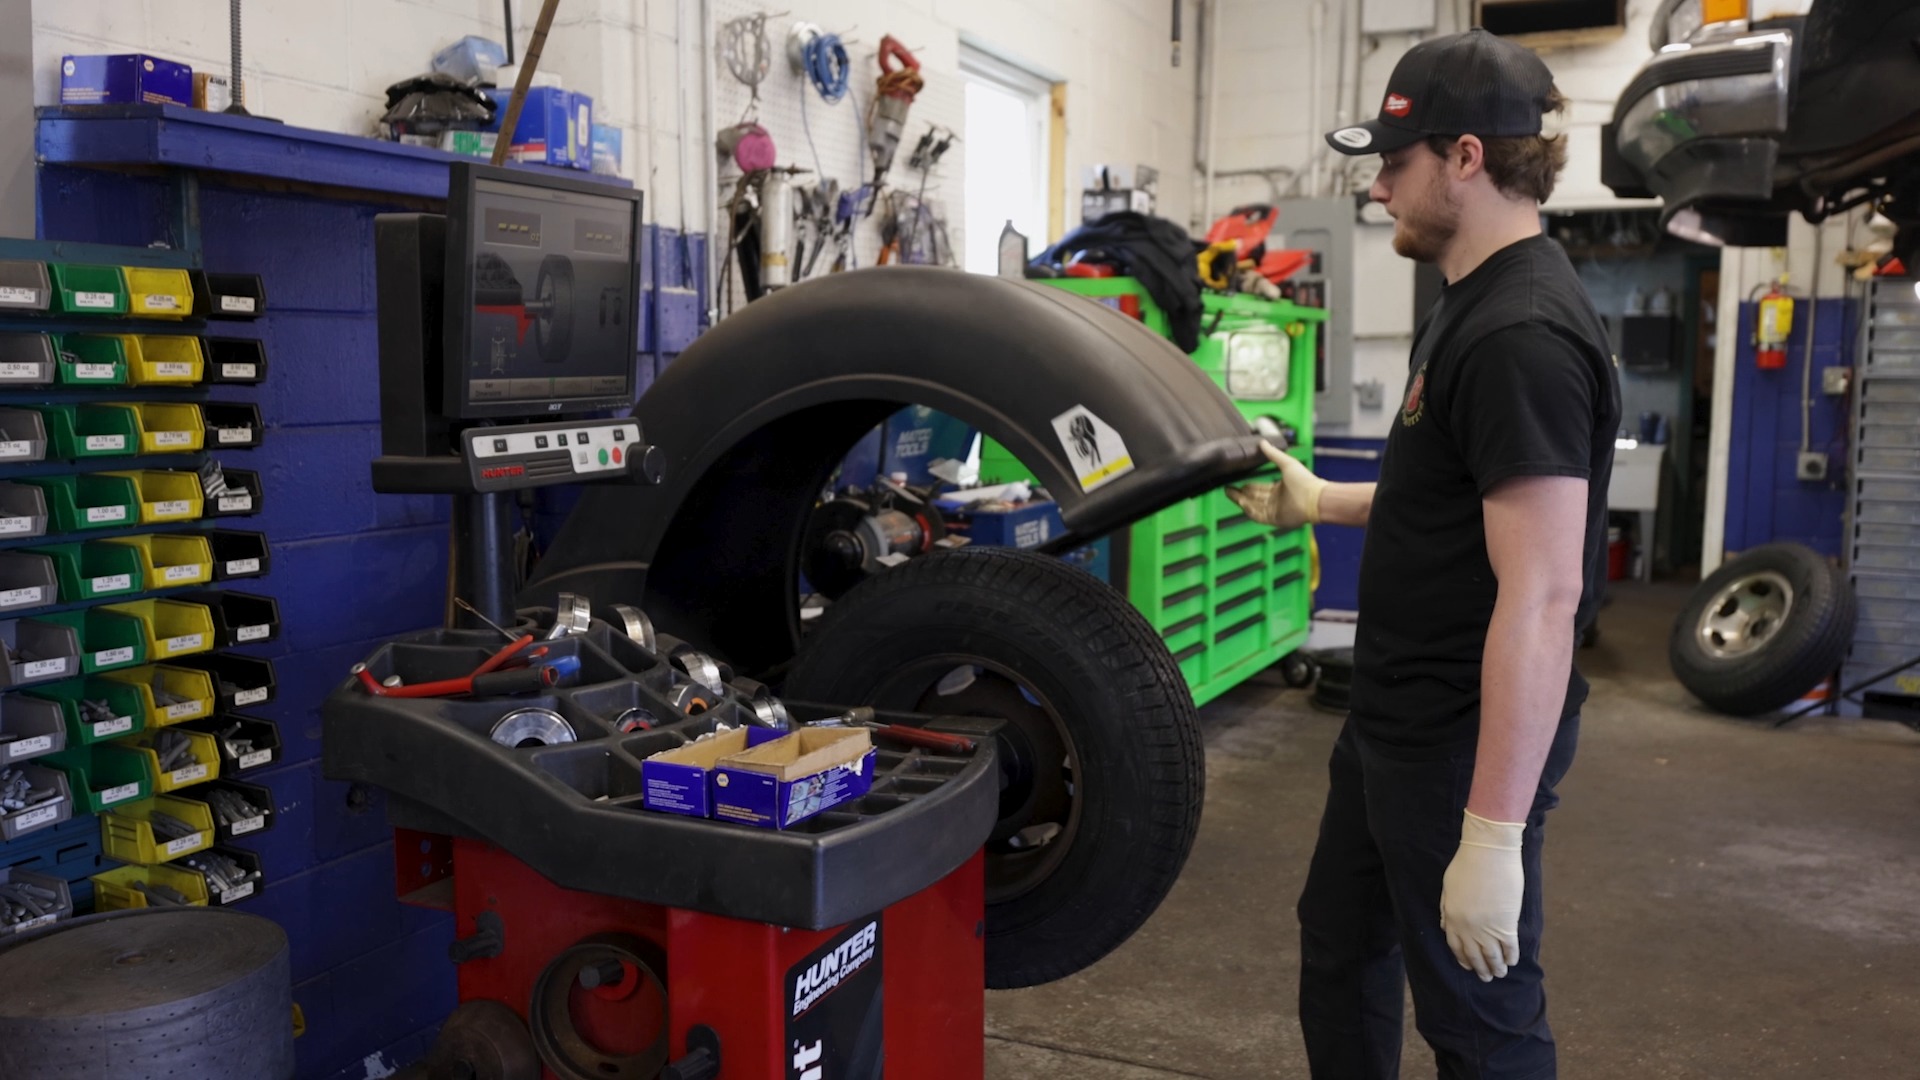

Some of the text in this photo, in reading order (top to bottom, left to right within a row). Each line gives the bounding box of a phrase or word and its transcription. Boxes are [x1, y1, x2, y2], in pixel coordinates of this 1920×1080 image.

[481, 465, 525, 479] HUNTER
[793, 945, 875, 1016] Engineering Company
[795, 921, 877, 1002] HUNTER
